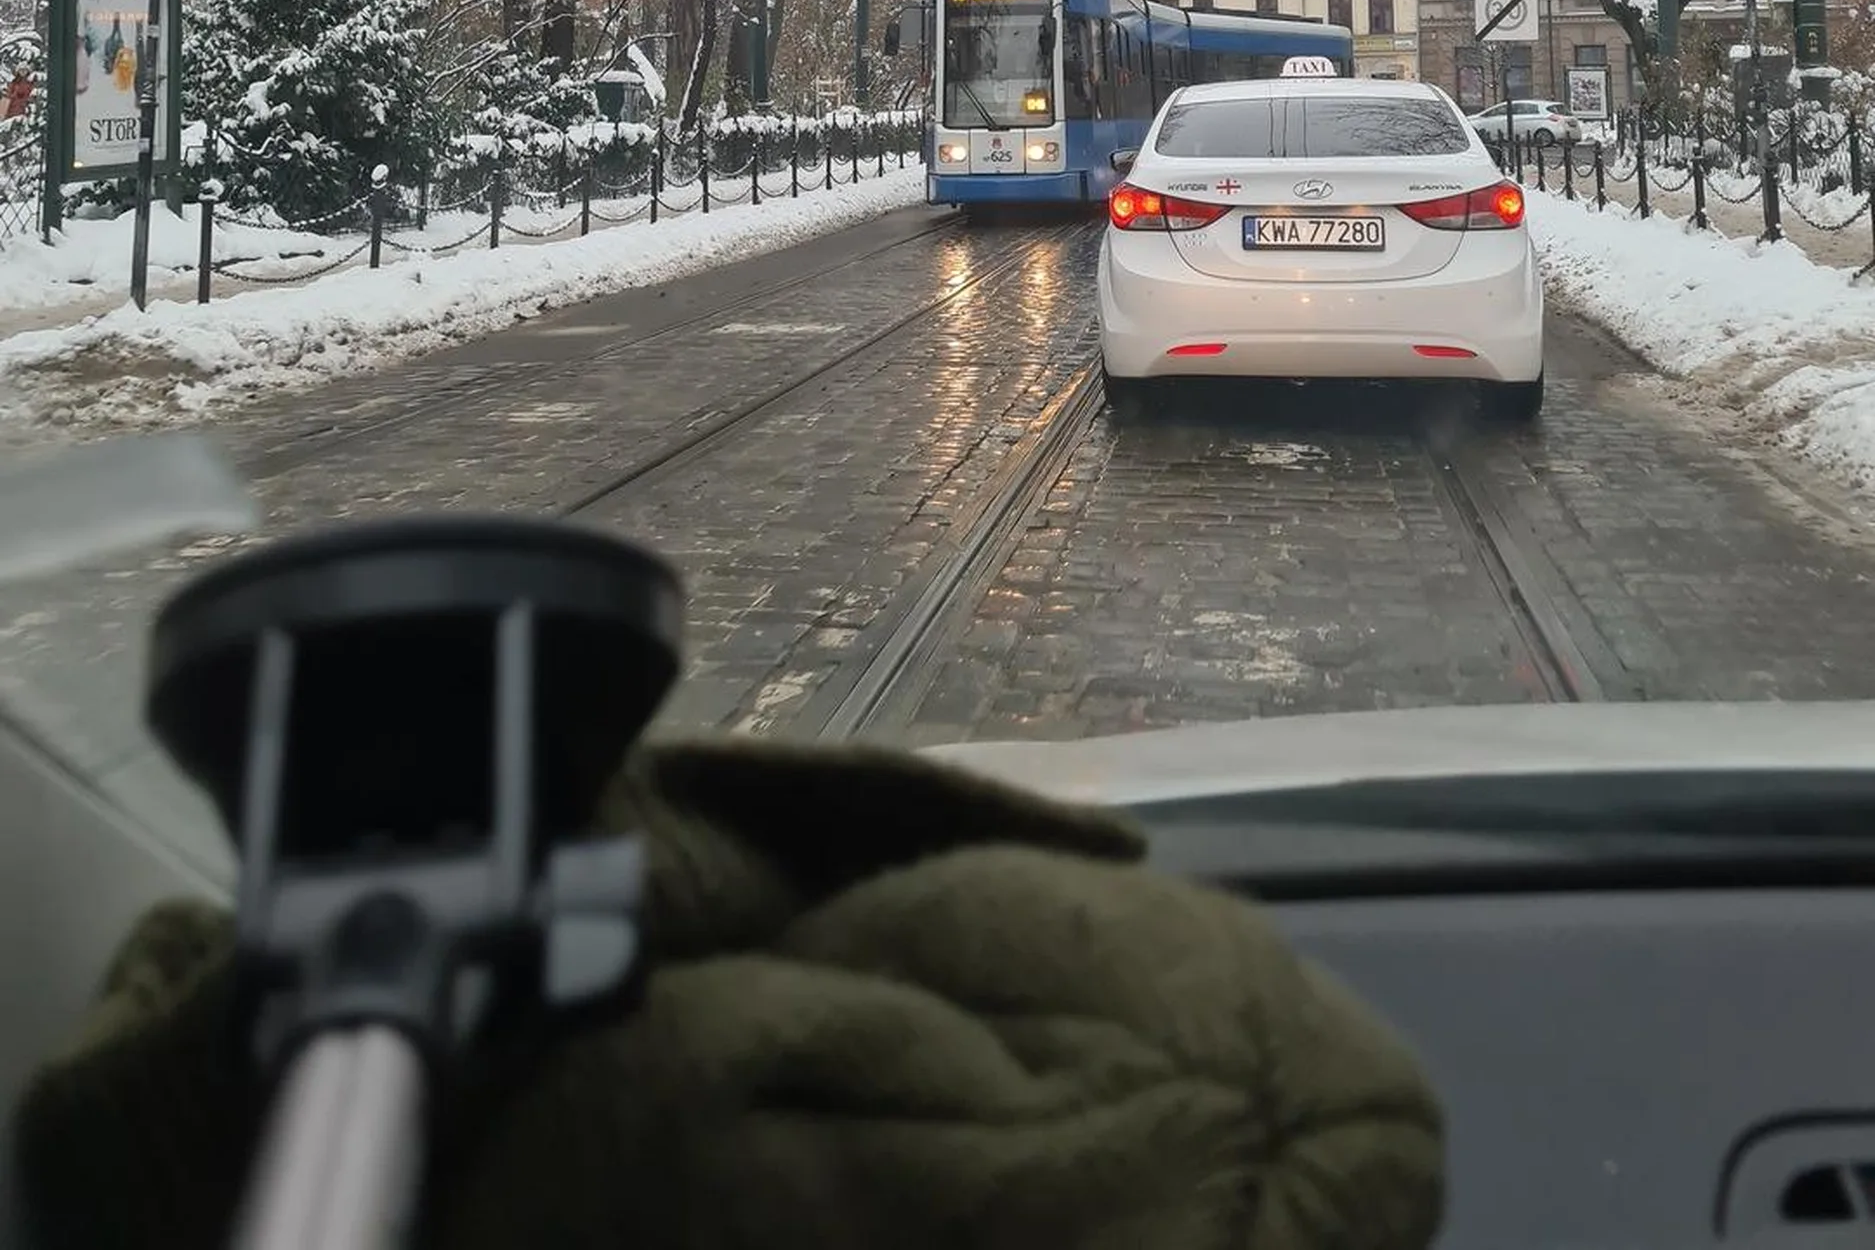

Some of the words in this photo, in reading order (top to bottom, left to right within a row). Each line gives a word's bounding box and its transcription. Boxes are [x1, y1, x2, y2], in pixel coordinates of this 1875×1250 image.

[1290, 60, 1327, 74] TAXI
[1256, 220, 1301, 243] KWA
[1308, 220, 1380, 244] 77280
